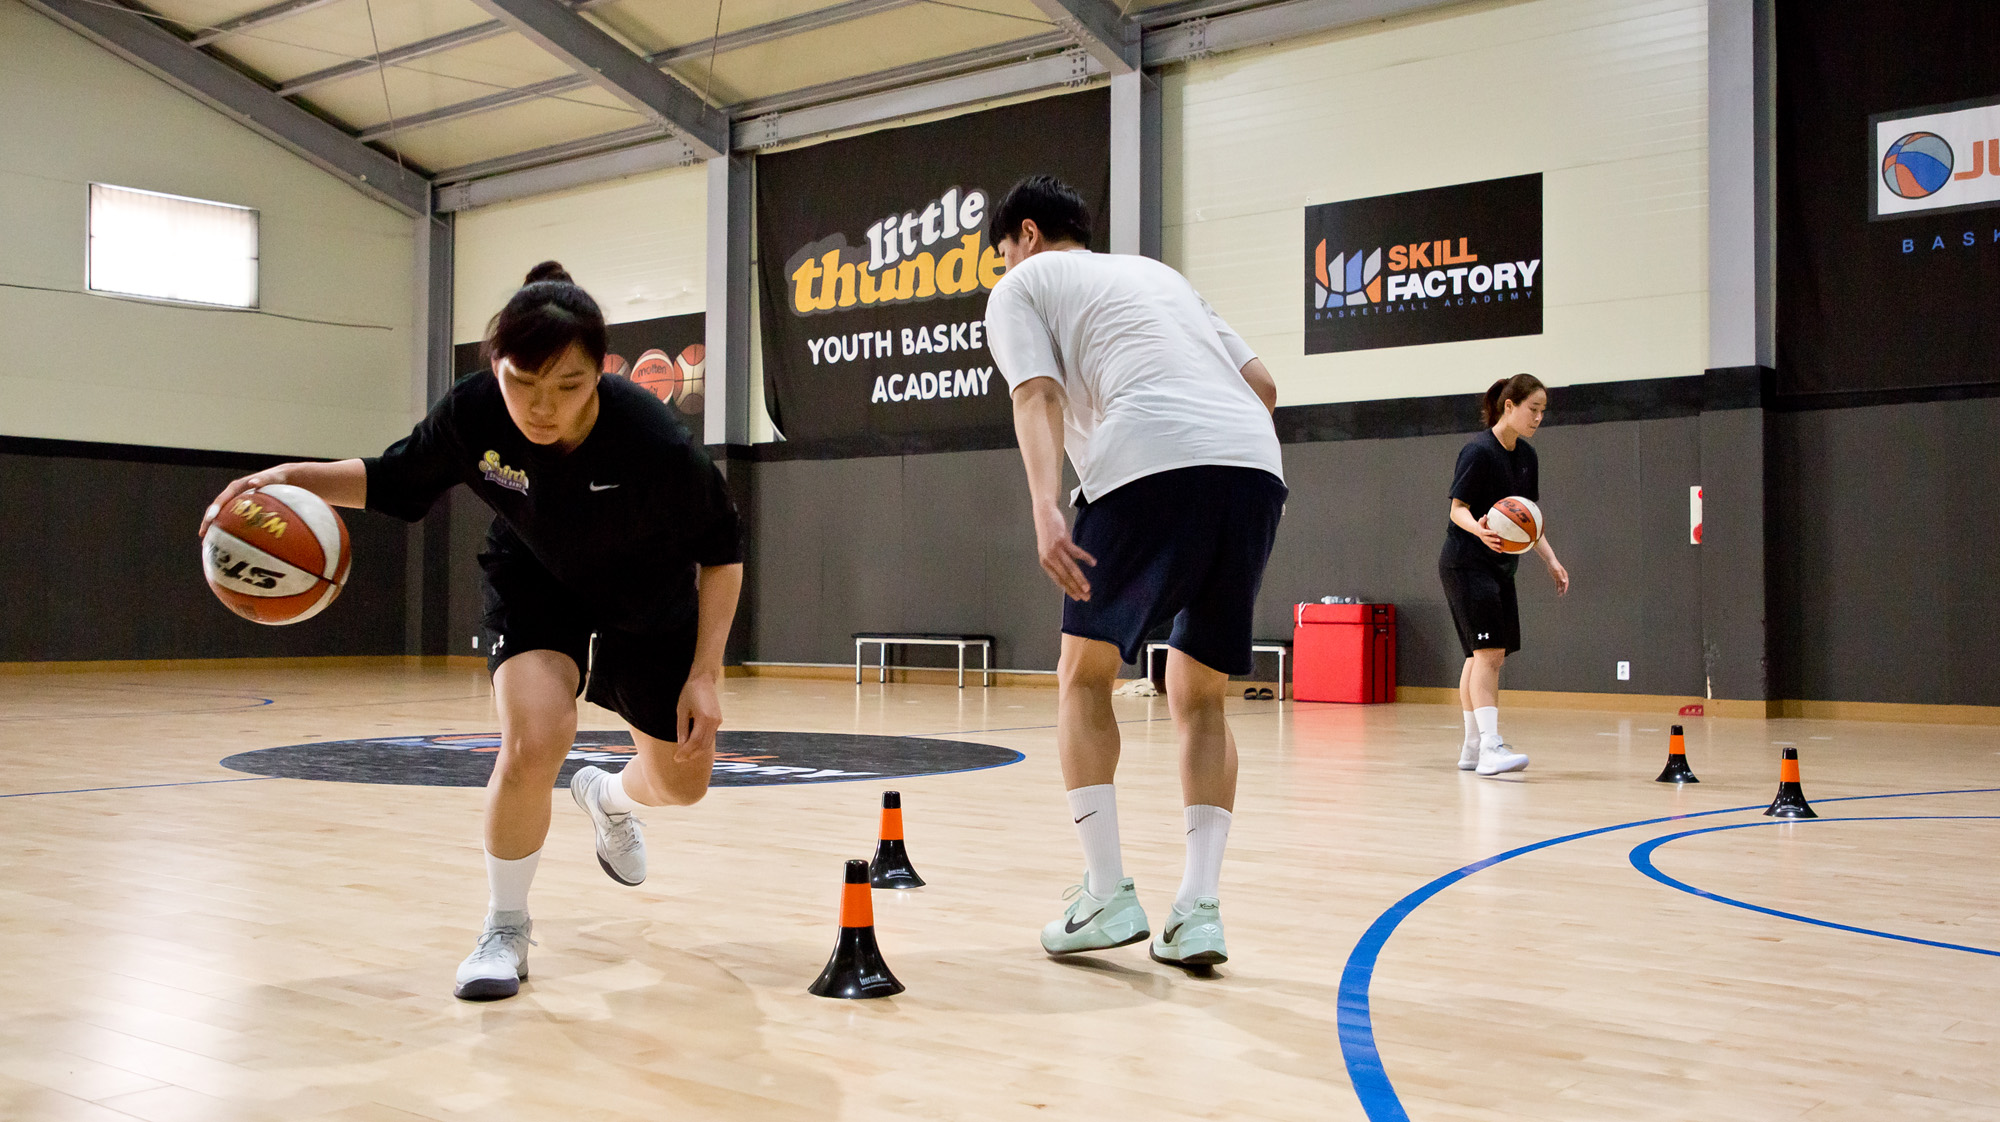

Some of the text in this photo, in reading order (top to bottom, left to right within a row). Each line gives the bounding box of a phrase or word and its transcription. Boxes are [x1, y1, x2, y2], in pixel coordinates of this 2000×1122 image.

[866, 188, 985, 271] little
[1387, 237, 1478, 272] SKILL
[1387, 259, 1541, 302] FACTORY
[1314, 291, 1533, 320] BASKETBALL ACADEMY
[808, 320, 987, 365] YOUTH BASKE
[871, 366, 993, 403] ACADEMY
